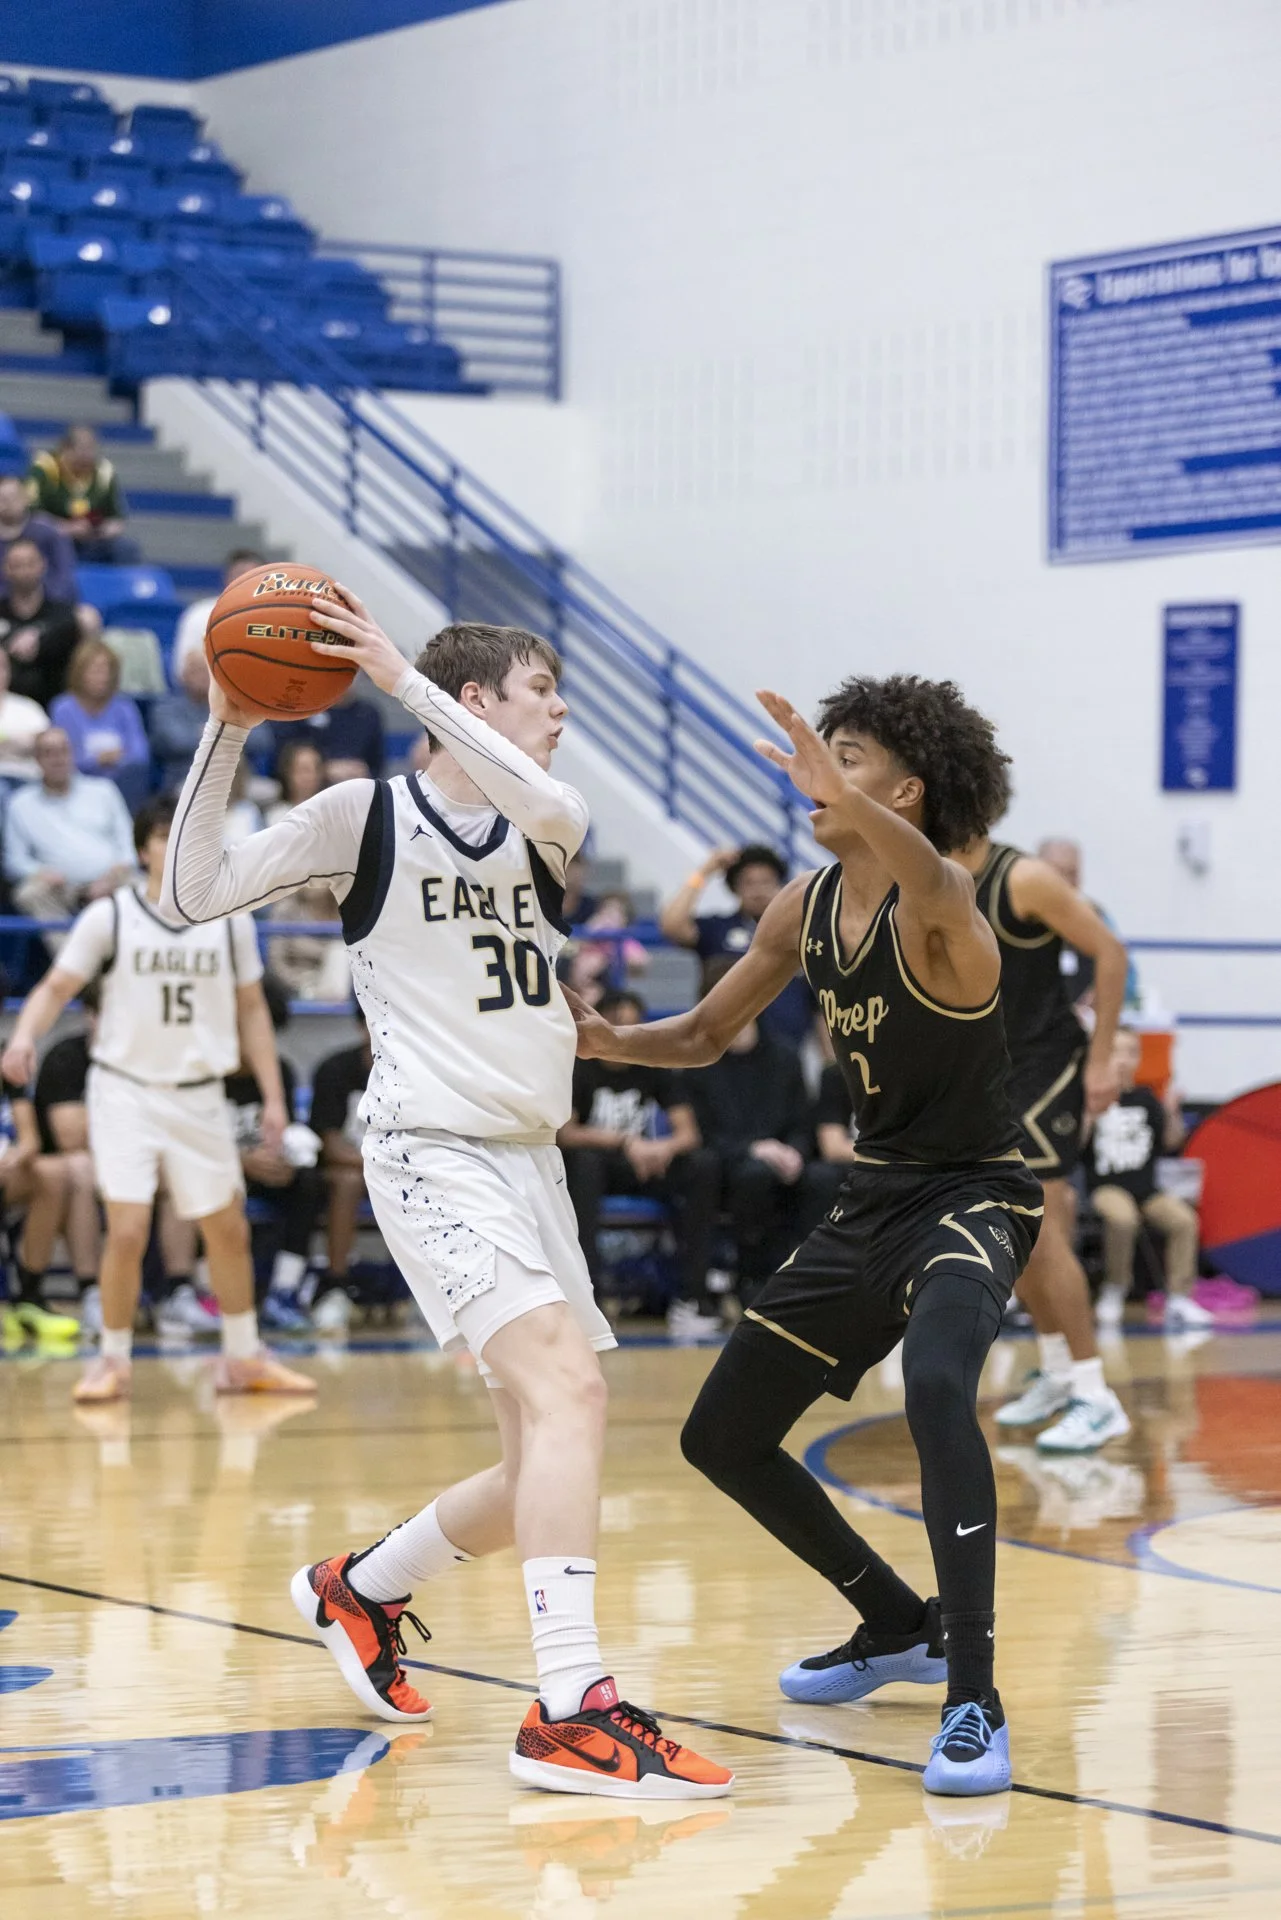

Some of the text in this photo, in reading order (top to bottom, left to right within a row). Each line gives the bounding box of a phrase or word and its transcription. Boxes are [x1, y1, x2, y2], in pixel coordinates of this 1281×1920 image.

[253, 573, 342, 598] Bade
[247, 624, 323, 643] ELITE
[134, 949, 219, 976] EAGLES
[472, 934, 551, 1012] 30
[161, 983, 195, 1025] 15
[819, 989, 890, 1043] Prep
[850, 1051, 881, 1094] 2
